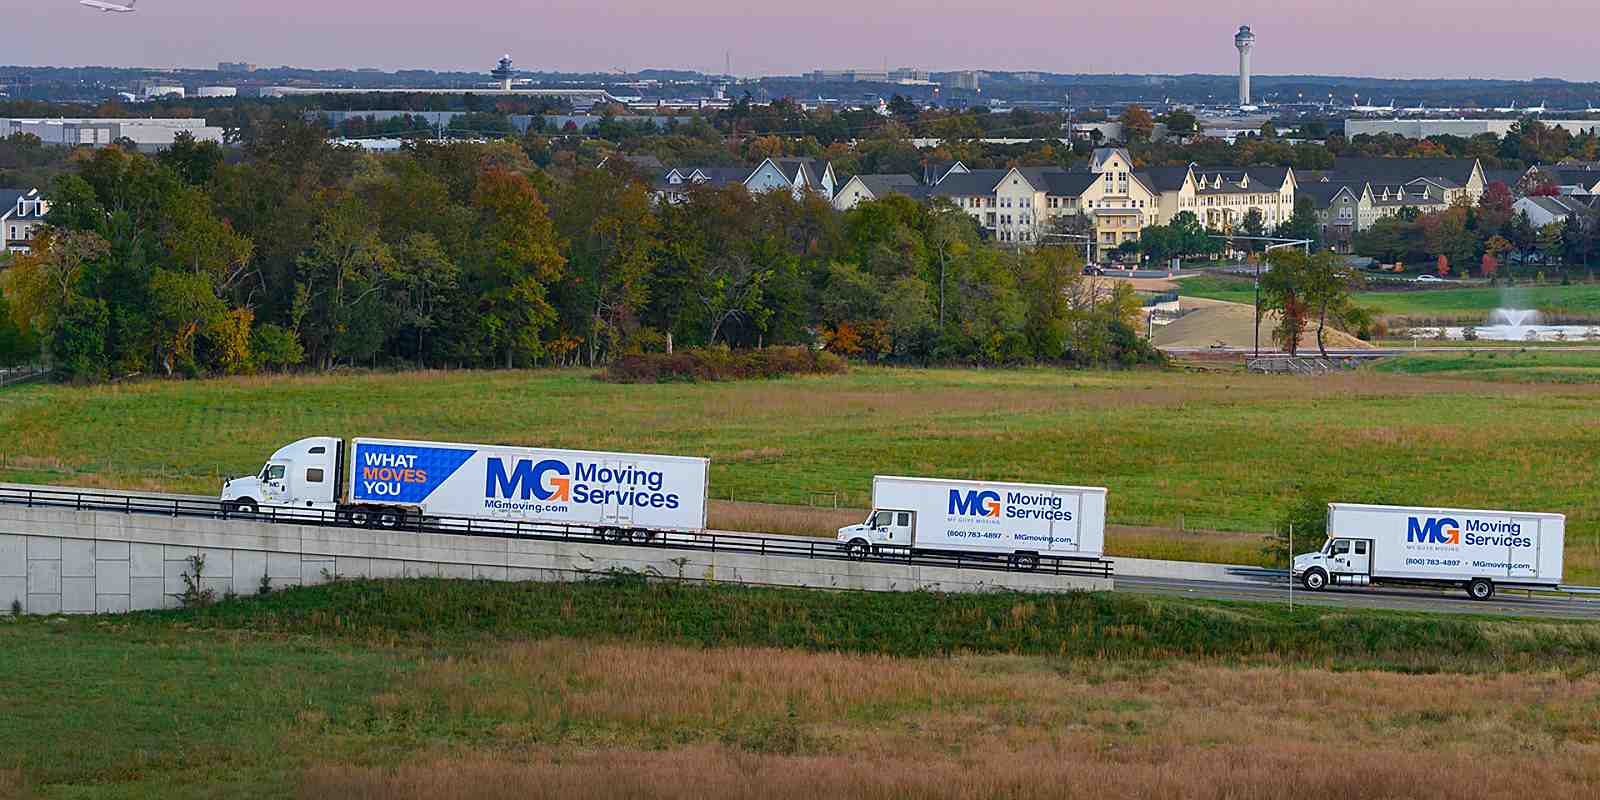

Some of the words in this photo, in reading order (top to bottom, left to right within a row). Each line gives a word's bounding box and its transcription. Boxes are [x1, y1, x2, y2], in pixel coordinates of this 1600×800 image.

[365, 452, 417, 468] WHAT
[363, 467, 427, 483] MOVES
[485, 457, 570, 502] MG
[574, 462, 663, 491] Moving
[364, 481, 401, 496] YOU
[573, 484, 680, 509] Services
[484, 499, 568, 513] MGmoving.com
[948, 489, 1001, 518] MG
[1006, 492, 1062, 510] Moving
[1006, 505, 1073, 521] Services
[1407, 516, 1460, 545] MG
[1465, 519, 1521, 536] Moving
[1014, 533, 1072, 544] MGmoving.com
[1465, 532, 1532, 548] Services
[1472, 560, 1530, 570] MGmoving.com
